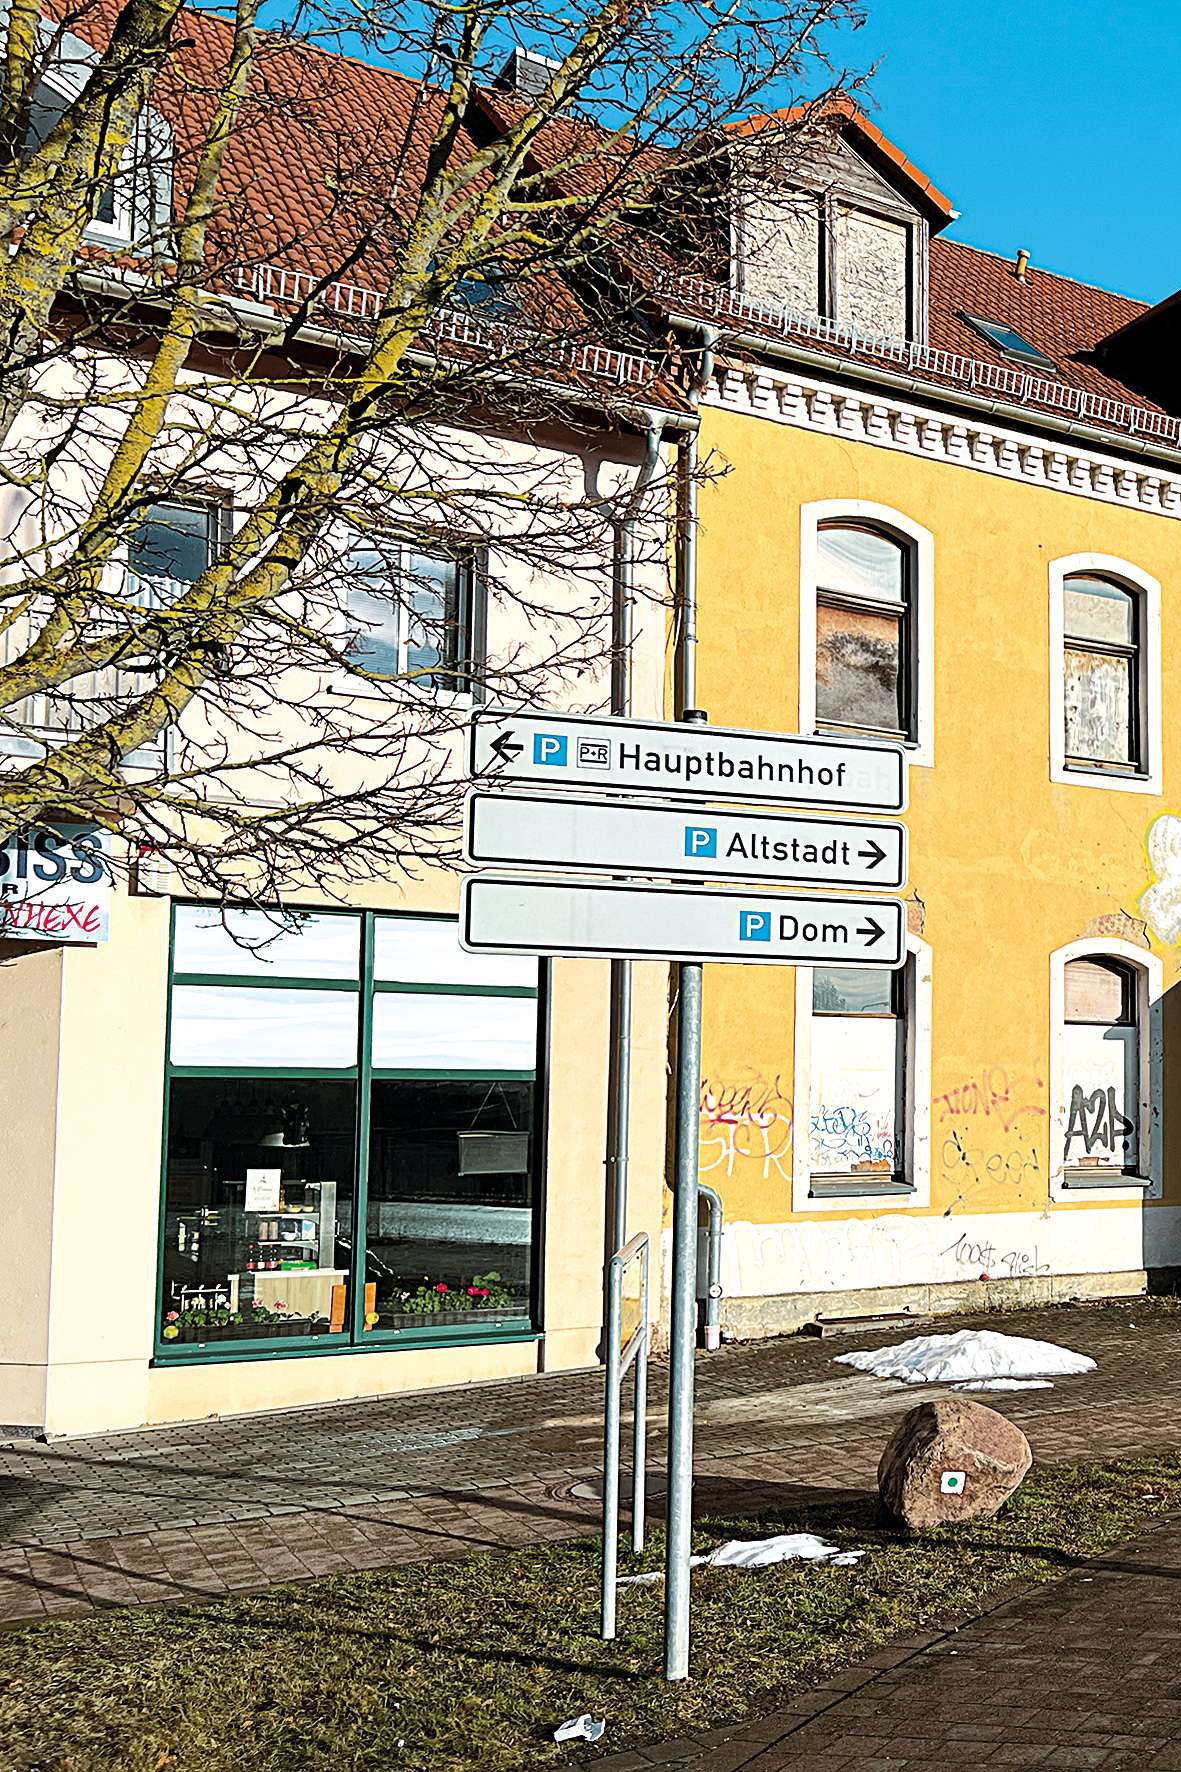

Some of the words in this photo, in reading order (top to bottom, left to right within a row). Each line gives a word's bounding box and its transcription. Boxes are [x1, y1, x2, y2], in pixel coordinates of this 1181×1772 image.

[619, 742, 846, 787] Hauptbahnhof
[725, 832, 850, 865] Altstadt
[779, 915, 848, 943] Dom
